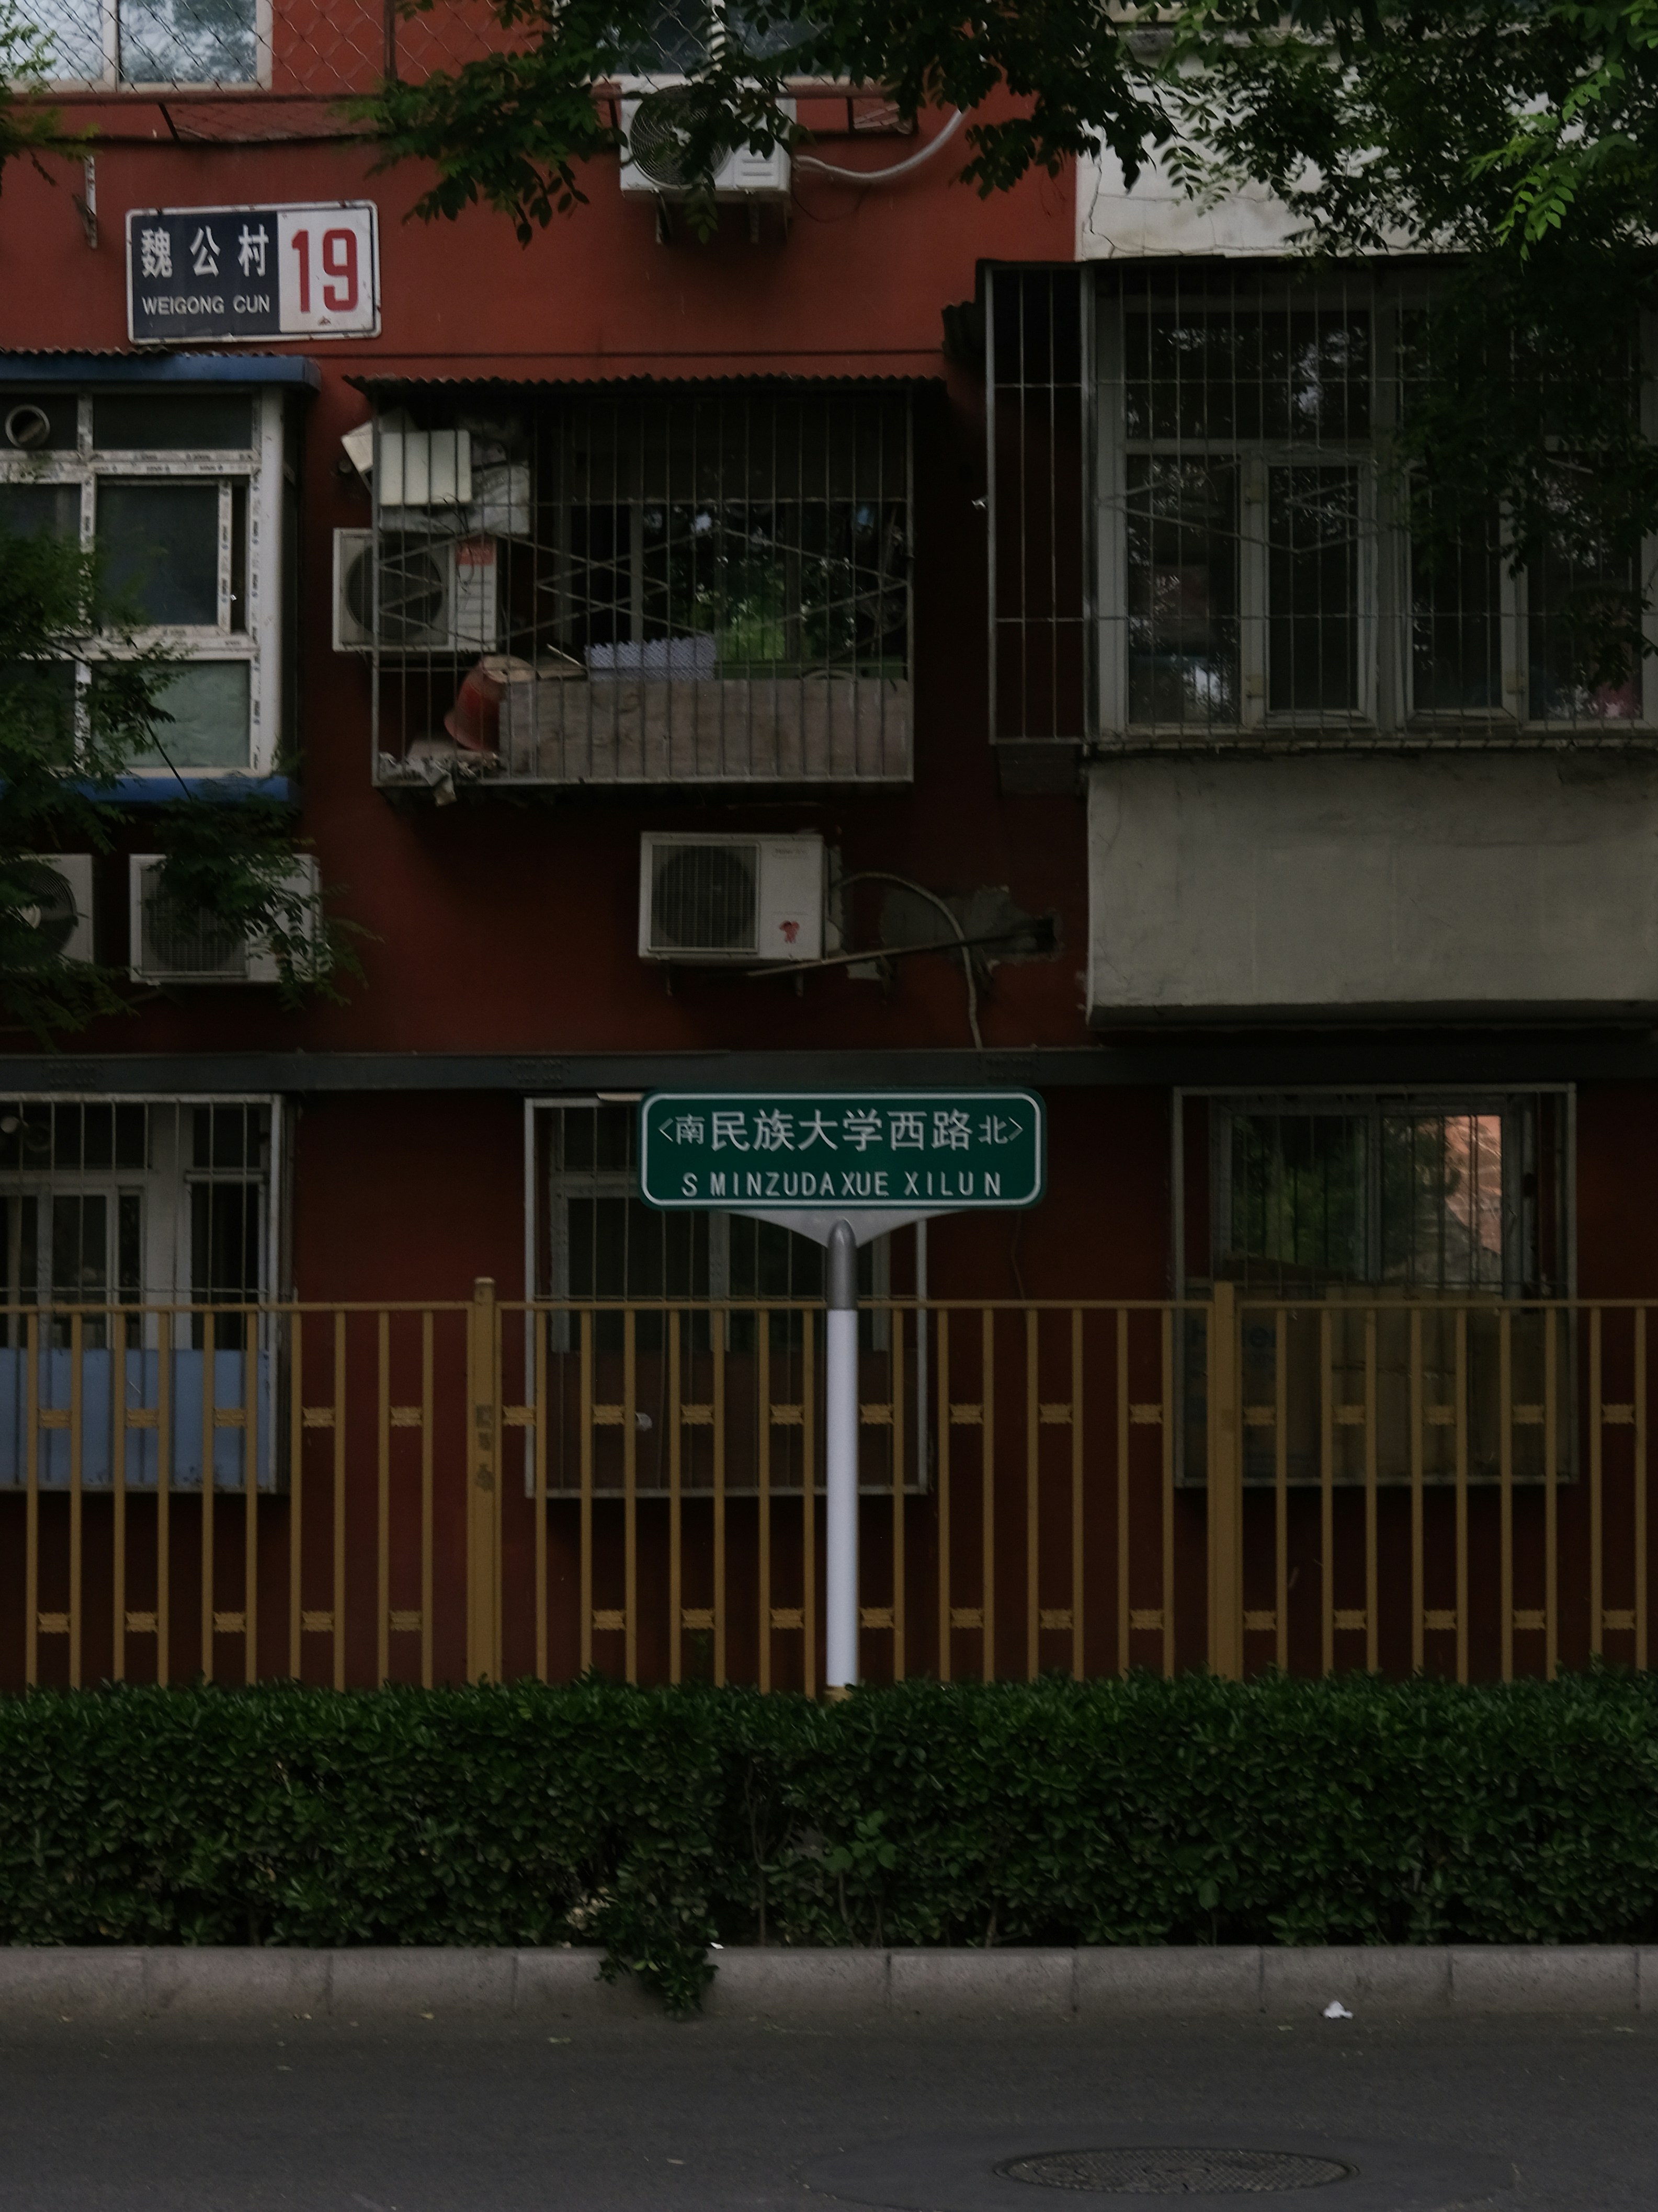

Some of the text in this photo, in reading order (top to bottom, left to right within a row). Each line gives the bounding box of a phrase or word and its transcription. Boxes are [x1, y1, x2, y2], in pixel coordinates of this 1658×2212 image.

[141, 224, 269, 278] 魏公村
[291, 227, 359, 313] 19
[142, 294, 270, 316] WEIGONG CUN
[682, 1171, 698, 1197] S
[710, 1171, 889, 1197] MINZUDAXUE
